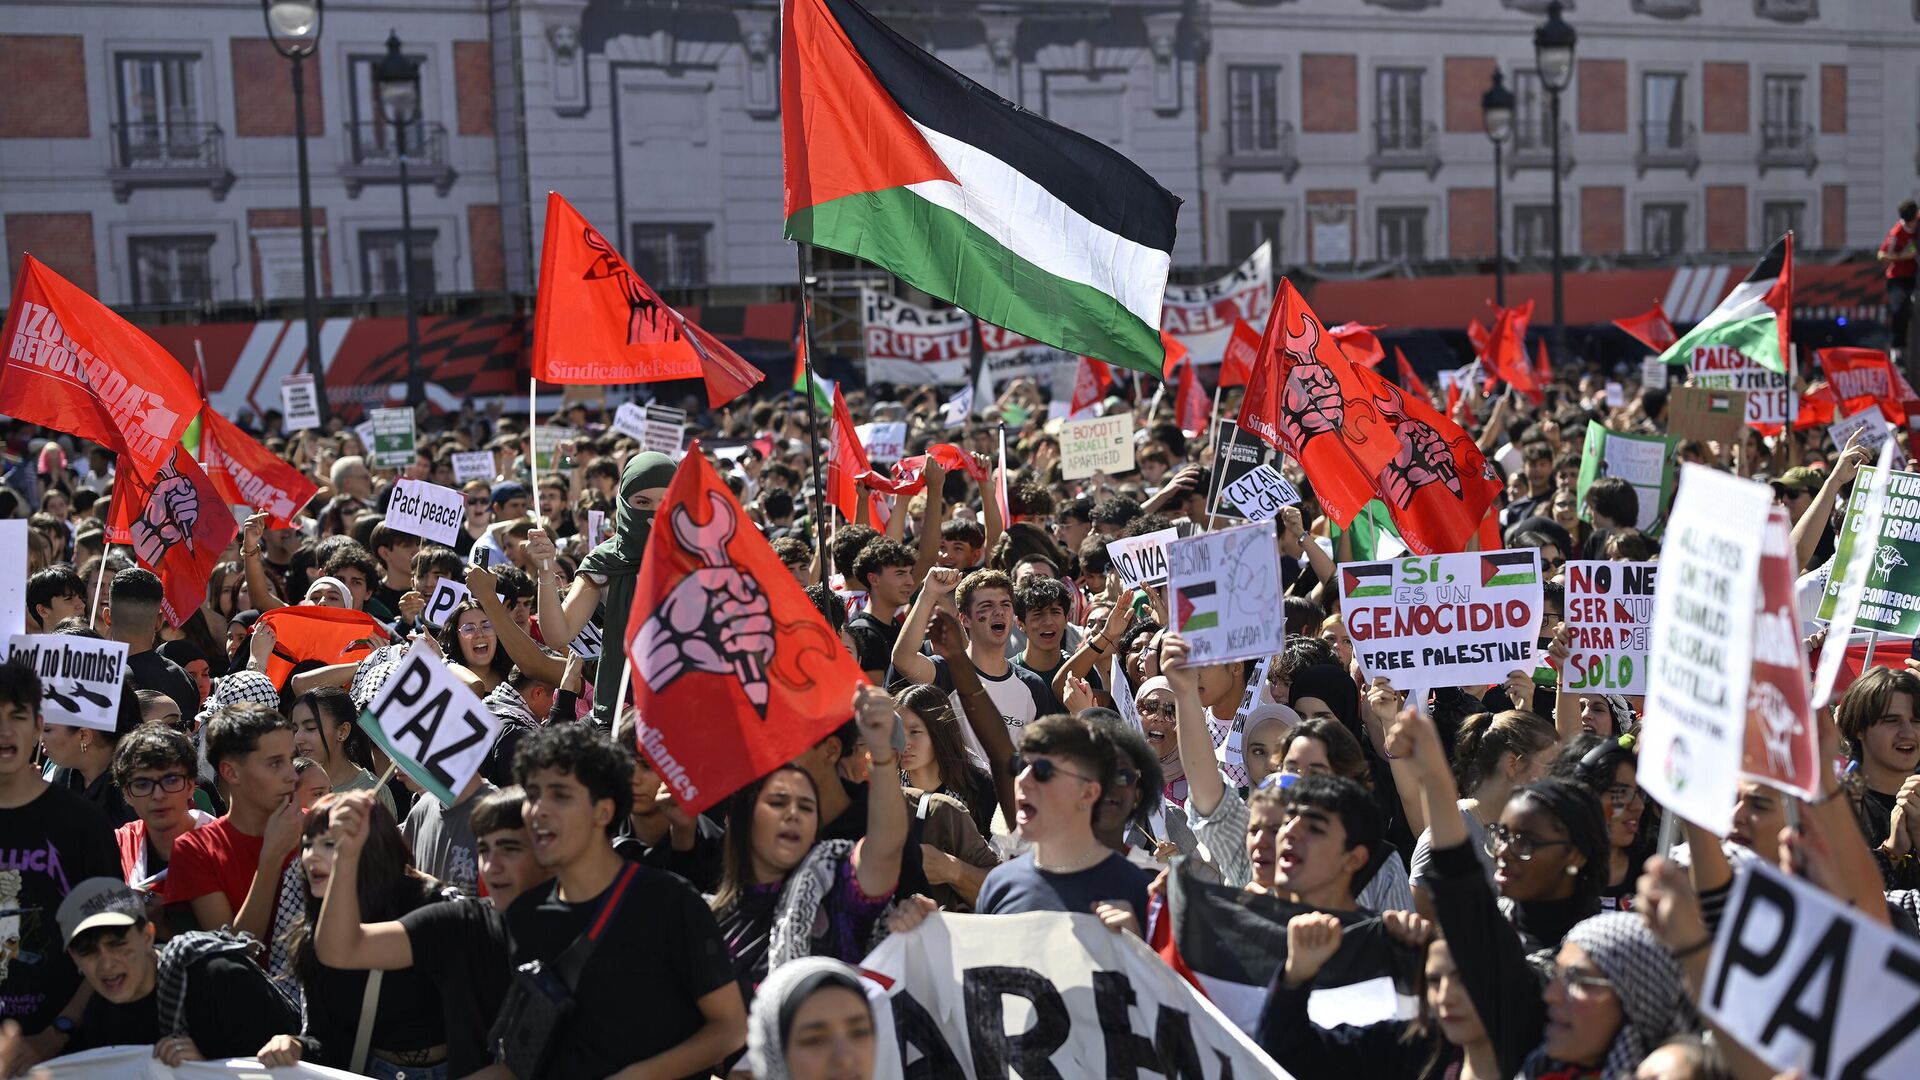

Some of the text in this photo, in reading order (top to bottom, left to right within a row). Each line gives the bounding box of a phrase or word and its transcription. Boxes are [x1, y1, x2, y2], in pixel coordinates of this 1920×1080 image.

[548, 360, 632, 379] Sindicato
[1073, 420, 1122, 440] BOYCOTT
[1064, 437, 1109, 455] ISRAELI
[1068, 450, 1120, 470] APARTHEID
[1228, 466, 1281, 505] CAZAN
[1258, 481, 1299, 512] GAZA!
[391, 486, 462, 528] Pact peace!
[1249, 509, 1266, 521] en
[1112, 545, 1168, 584] NO WA
[1401, 556, 1455, 584] SÍ,
[1570, 565, 1612, 594] NO
[1394, 584, 1471, 605] ES UN
[1861, 586, 1920, 612] COMERCIO
[1349, 599, 1531, 641] GENOCIDIO
[1569, 598, 1608, 623] SER
[1857, 604, 1902, 626] ARMAS
[1568, 627, 1615, 650] PARA
[40, 648, 60, 678] no
[61, 643, 123, 684] bombs!
[1363, 641, 1531, 670] FREE PALESTINE
[1568, 654, 1633, 689] SOLO
[374, 655, 489, 788] PAZ
[1712, 868, 1920, 1080] PAZ
